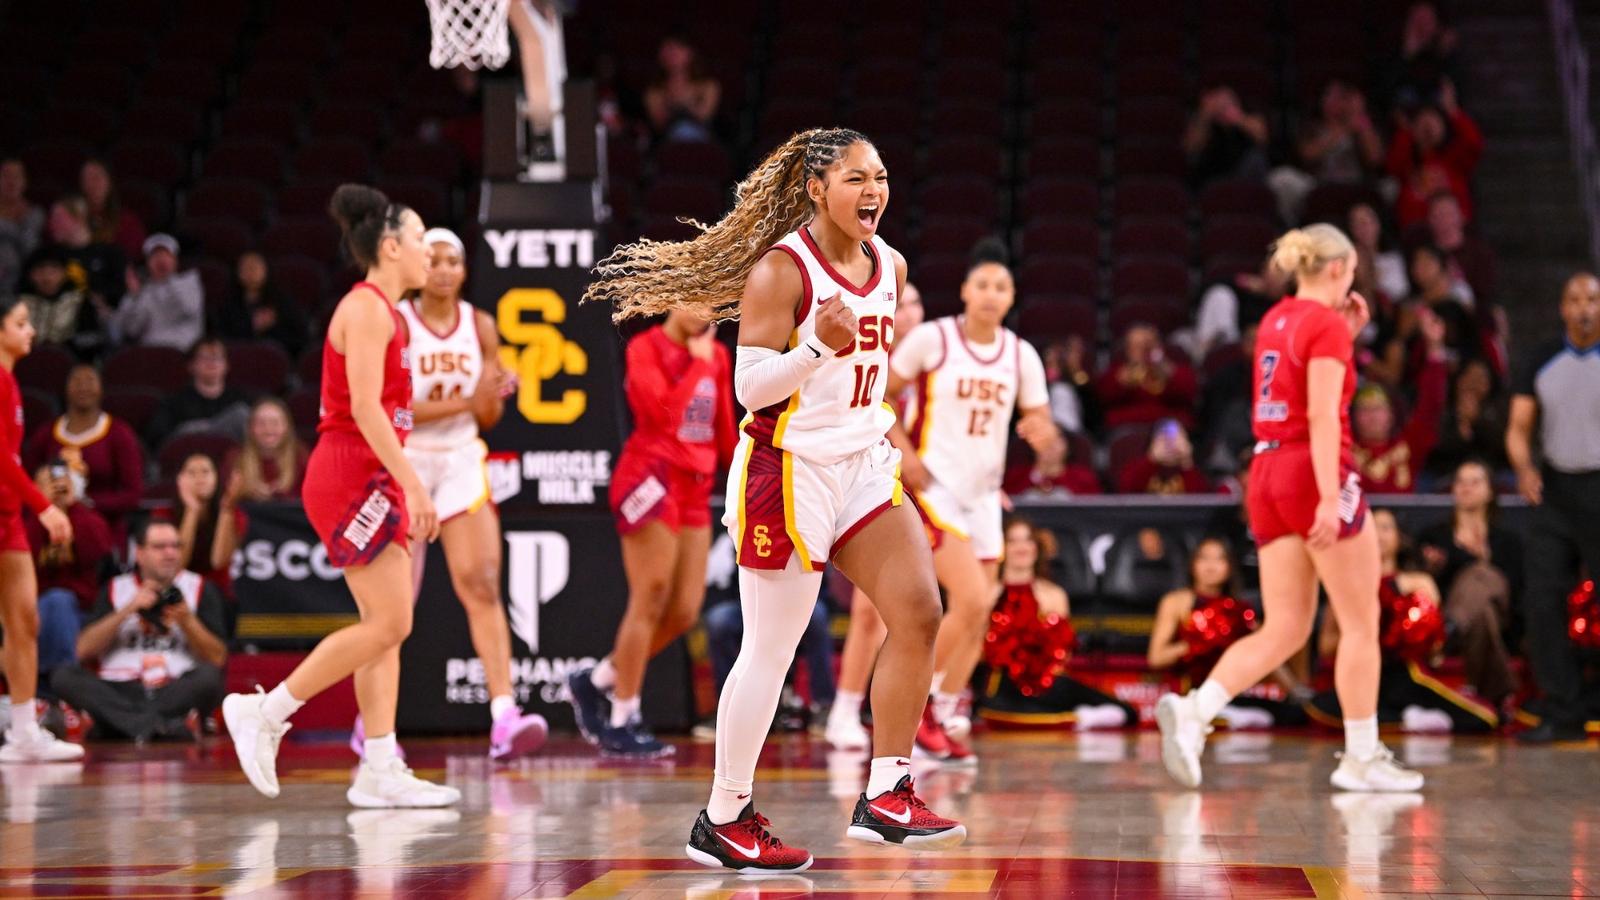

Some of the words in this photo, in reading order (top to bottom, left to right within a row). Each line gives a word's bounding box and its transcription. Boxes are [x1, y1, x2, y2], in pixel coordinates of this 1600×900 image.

[484, 229, 593, 267] YETI
[834, 314, 894, 358] SC
[419, 352, 471, 376] USC
[1260, 350, 1280, 401] 7
[849, 364, 879, 408] 10
[957, 378, 1007, 407] USC
[968, 408, 992, 436] 12
[522, 450, 611, 480] MUSCLE
[538, 479, 596, 504] MILK
